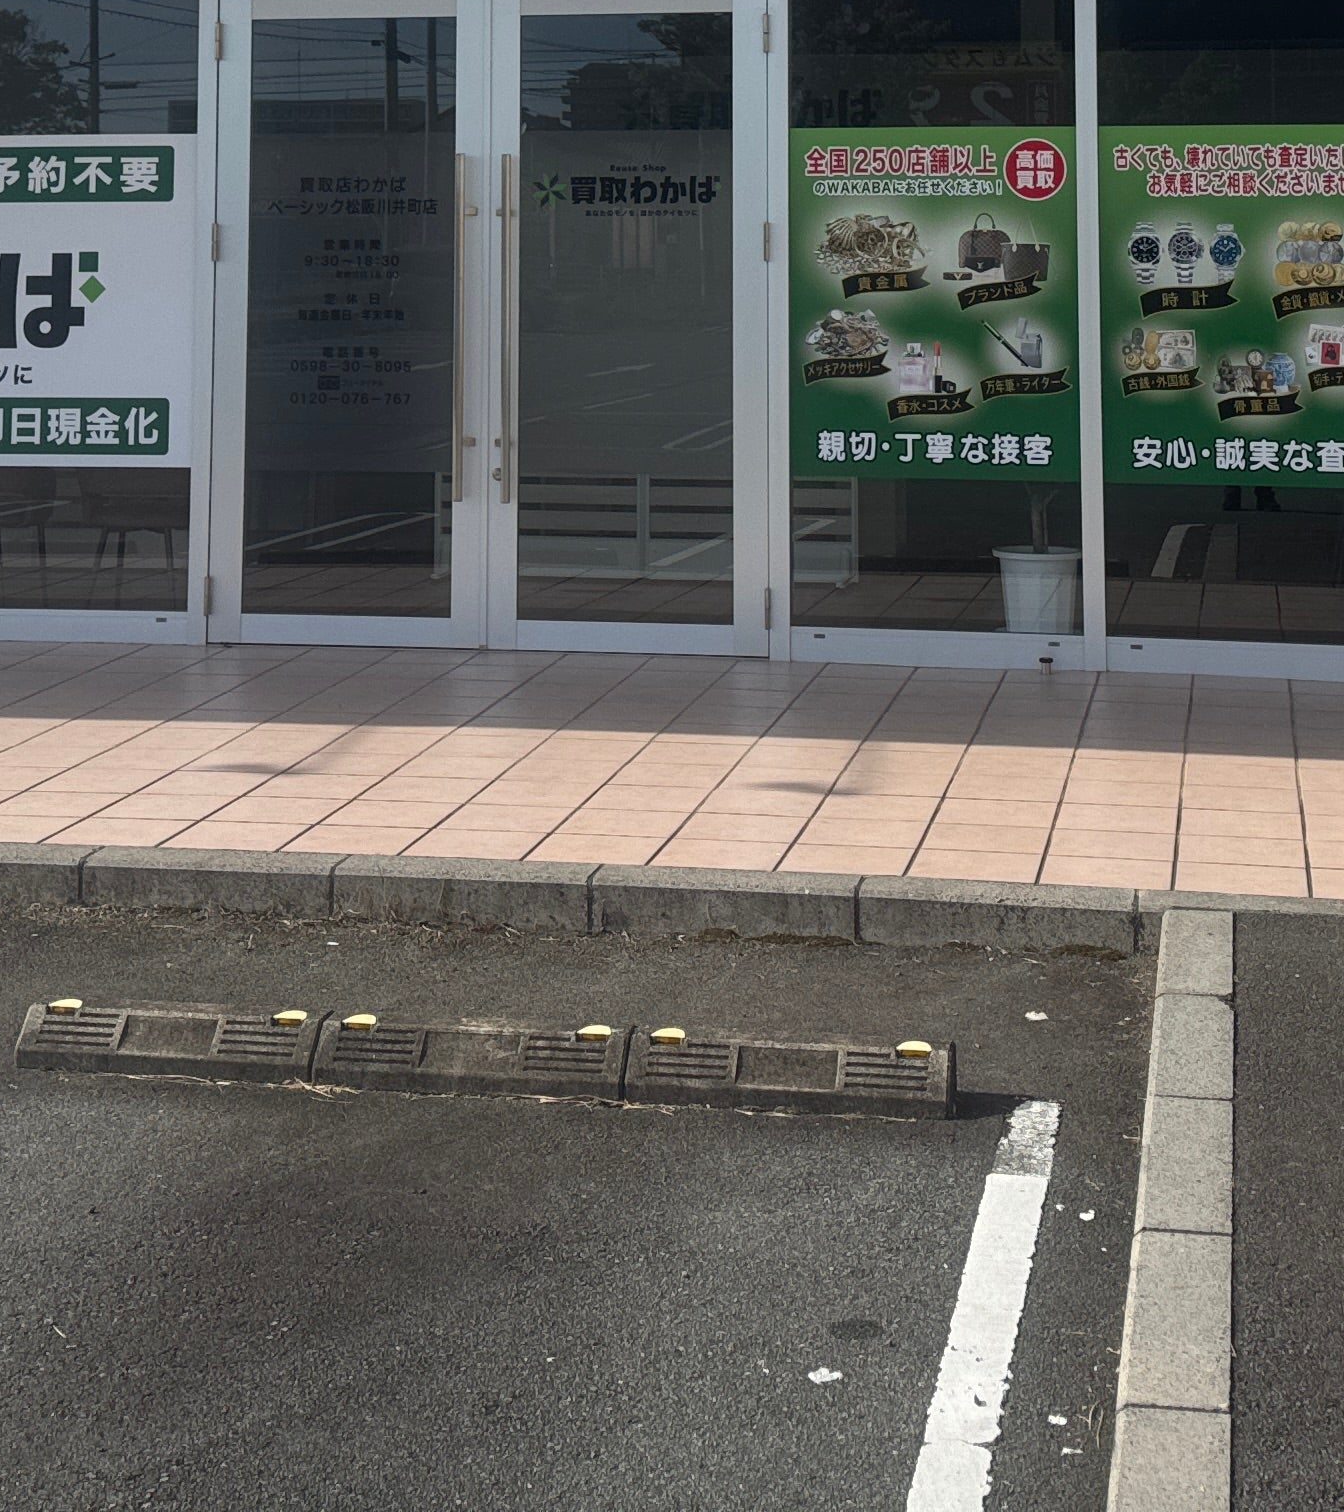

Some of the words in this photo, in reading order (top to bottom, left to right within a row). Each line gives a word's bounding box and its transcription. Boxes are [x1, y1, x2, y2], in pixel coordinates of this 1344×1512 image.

[806, 147, 996, 175] 全国250店舗以上
[1016, 150, 1055, 169] 高価
[570, 175, 723, 204] 買取わかば
[1016, 171, 1055, 189] 買取
[857, 274, 908, 291] 貴金属
[966, 282, 1028, 304] ブランド品
[807, 360, 881, 377] メッキアクセサリー
[818, 431, 1053, 465] 親切・丁寧な接客
